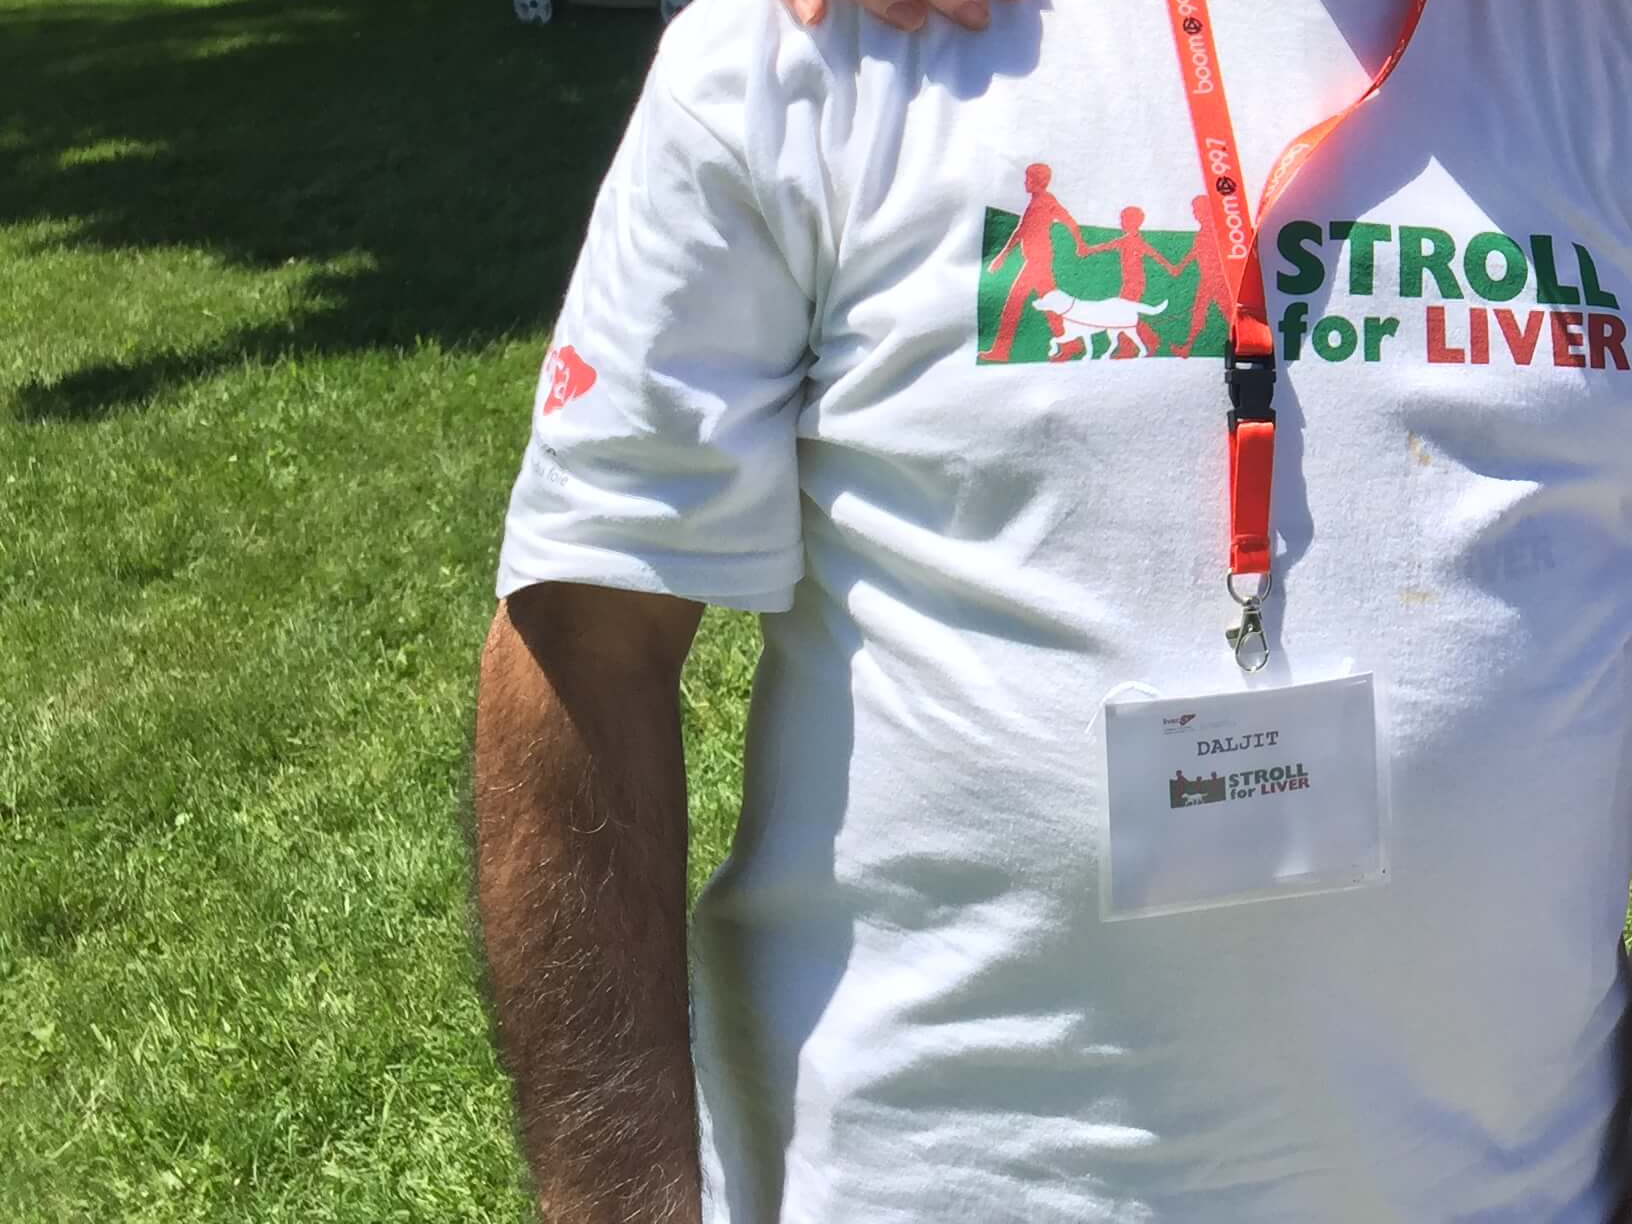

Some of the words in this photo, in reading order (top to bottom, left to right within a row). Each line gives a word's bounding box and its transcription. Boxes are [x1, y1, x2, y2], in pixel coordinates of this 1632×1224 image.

[1188, 32, 1214, 95] boom
[1222, 195, 1248, 260] boom
[1276, 219, 1621, 311] STROLL
[1278, 301, 1400, 362] for
[1426, 305, 1631, 371] LIVER
[1196, 730, 1279, 756] DALJIT
[1228, 763, 1308, 788] STROLL
[1230, 787, 1257, 800] for
[1261, 777, 1310, 796] LIVER
